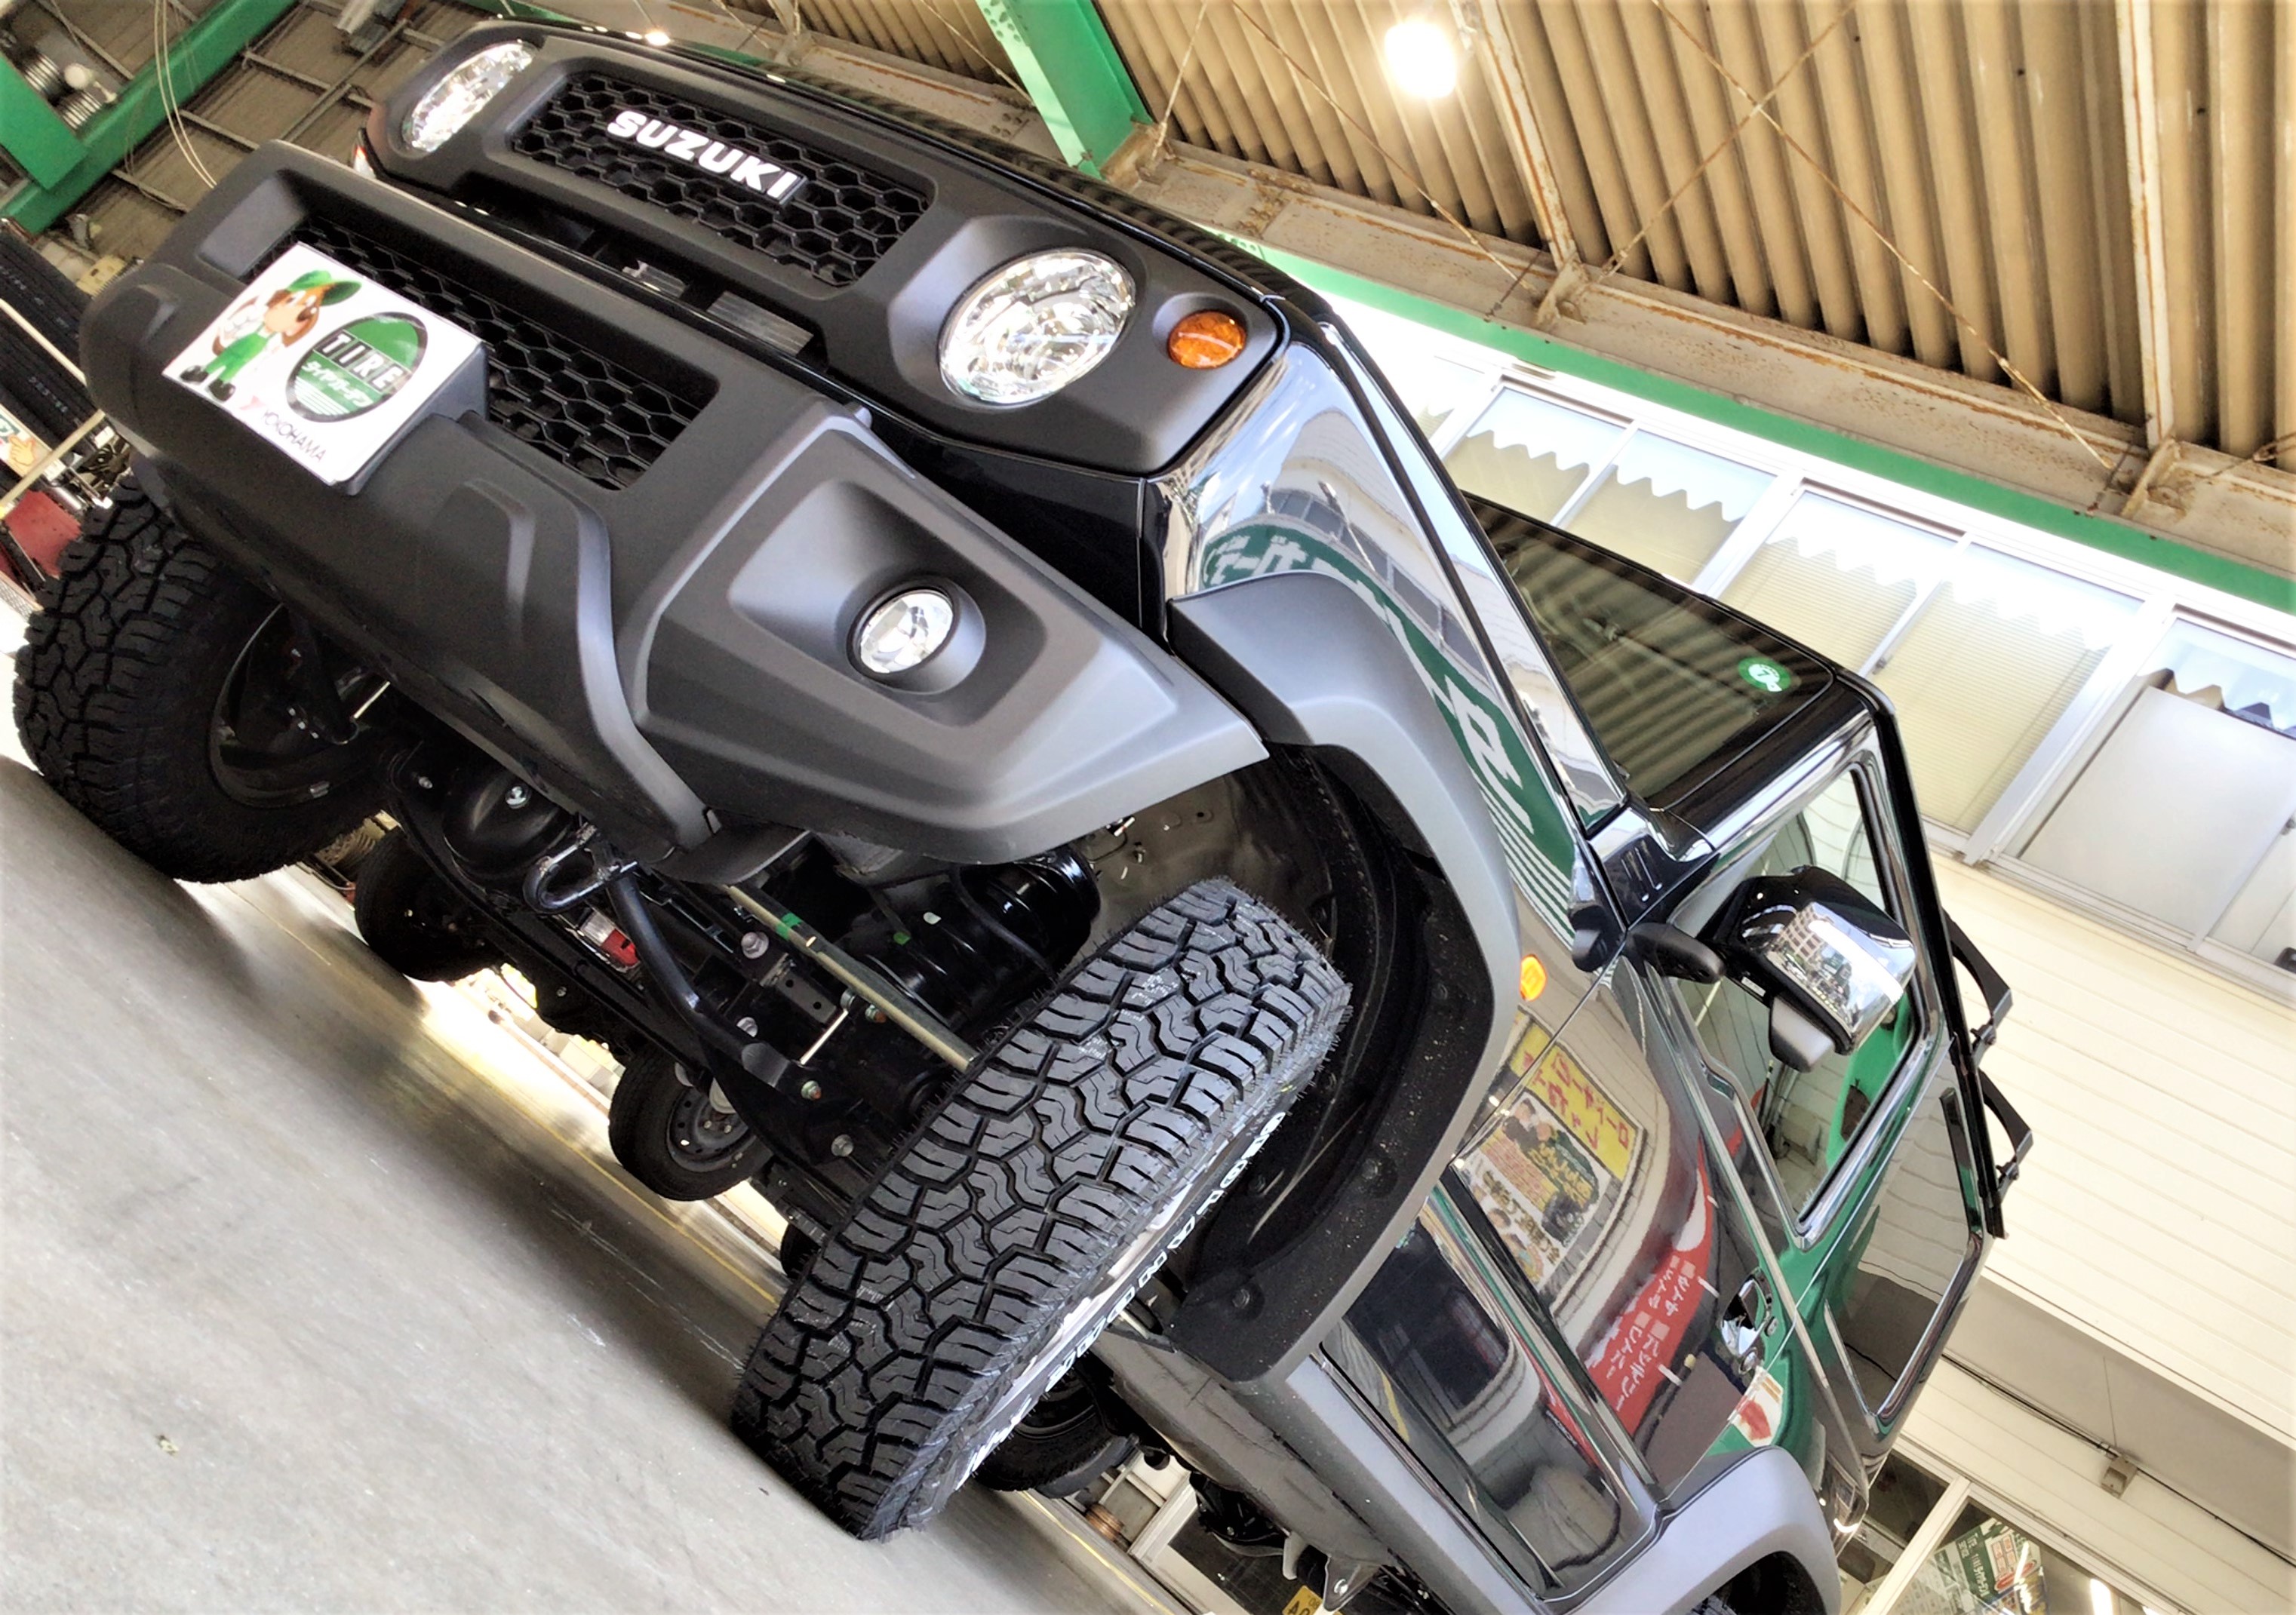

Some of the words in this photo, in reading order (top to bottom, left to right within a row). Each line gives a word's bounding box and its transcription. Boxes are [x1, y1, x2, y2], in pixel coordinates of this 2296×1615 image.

[607, 110, 798, 201] SUZUKI
[322, 333, 404, 389] TIRE
[261, 410, 327, 461] YOKOHAMA
[1045, 1112, 1286, 1392] GEOLANDAR
